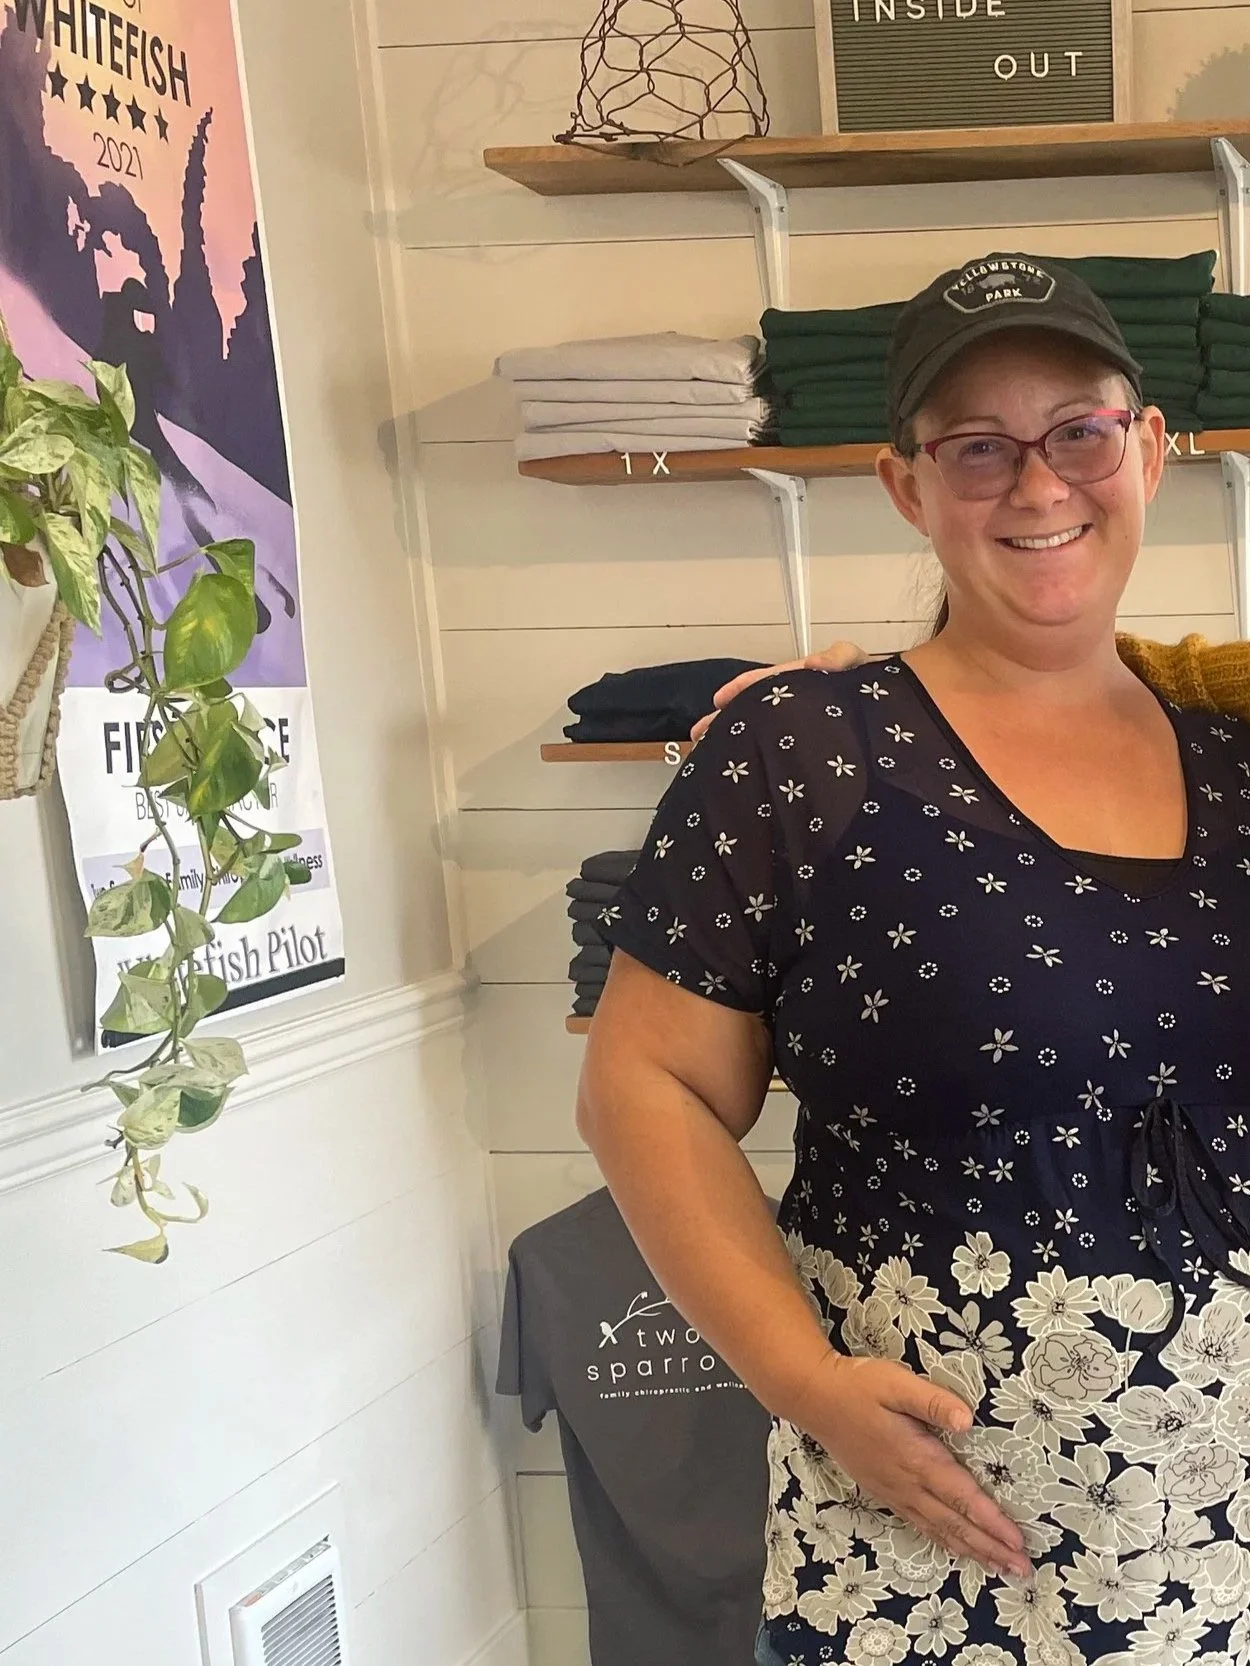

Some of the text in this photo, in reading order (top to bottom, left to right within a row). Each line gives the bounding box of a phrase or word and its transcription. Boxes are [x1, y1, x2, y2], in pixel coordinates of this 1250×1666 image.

[851, 0, 1006, 23] INSIDE
[14, 0, 192, 108] WHITEFISH
[994, 51, 1083, 80] OUT
[93, 131, 144, 181] 2021
[951, 261, 1044, 291] YELLOWSTONE
[985, 287, 1023, 303] PARK
[663, 740, 682, 766] S
[165, 868, 204, 894] Fmily
[267, 923, 328, 975] Pilot
[636, 1327, 701, 1348] two
[587, 1354, 716, 1385] sparro
[600, 1390, 631, 1400] family
[694, 1383, 712, 1393] and
